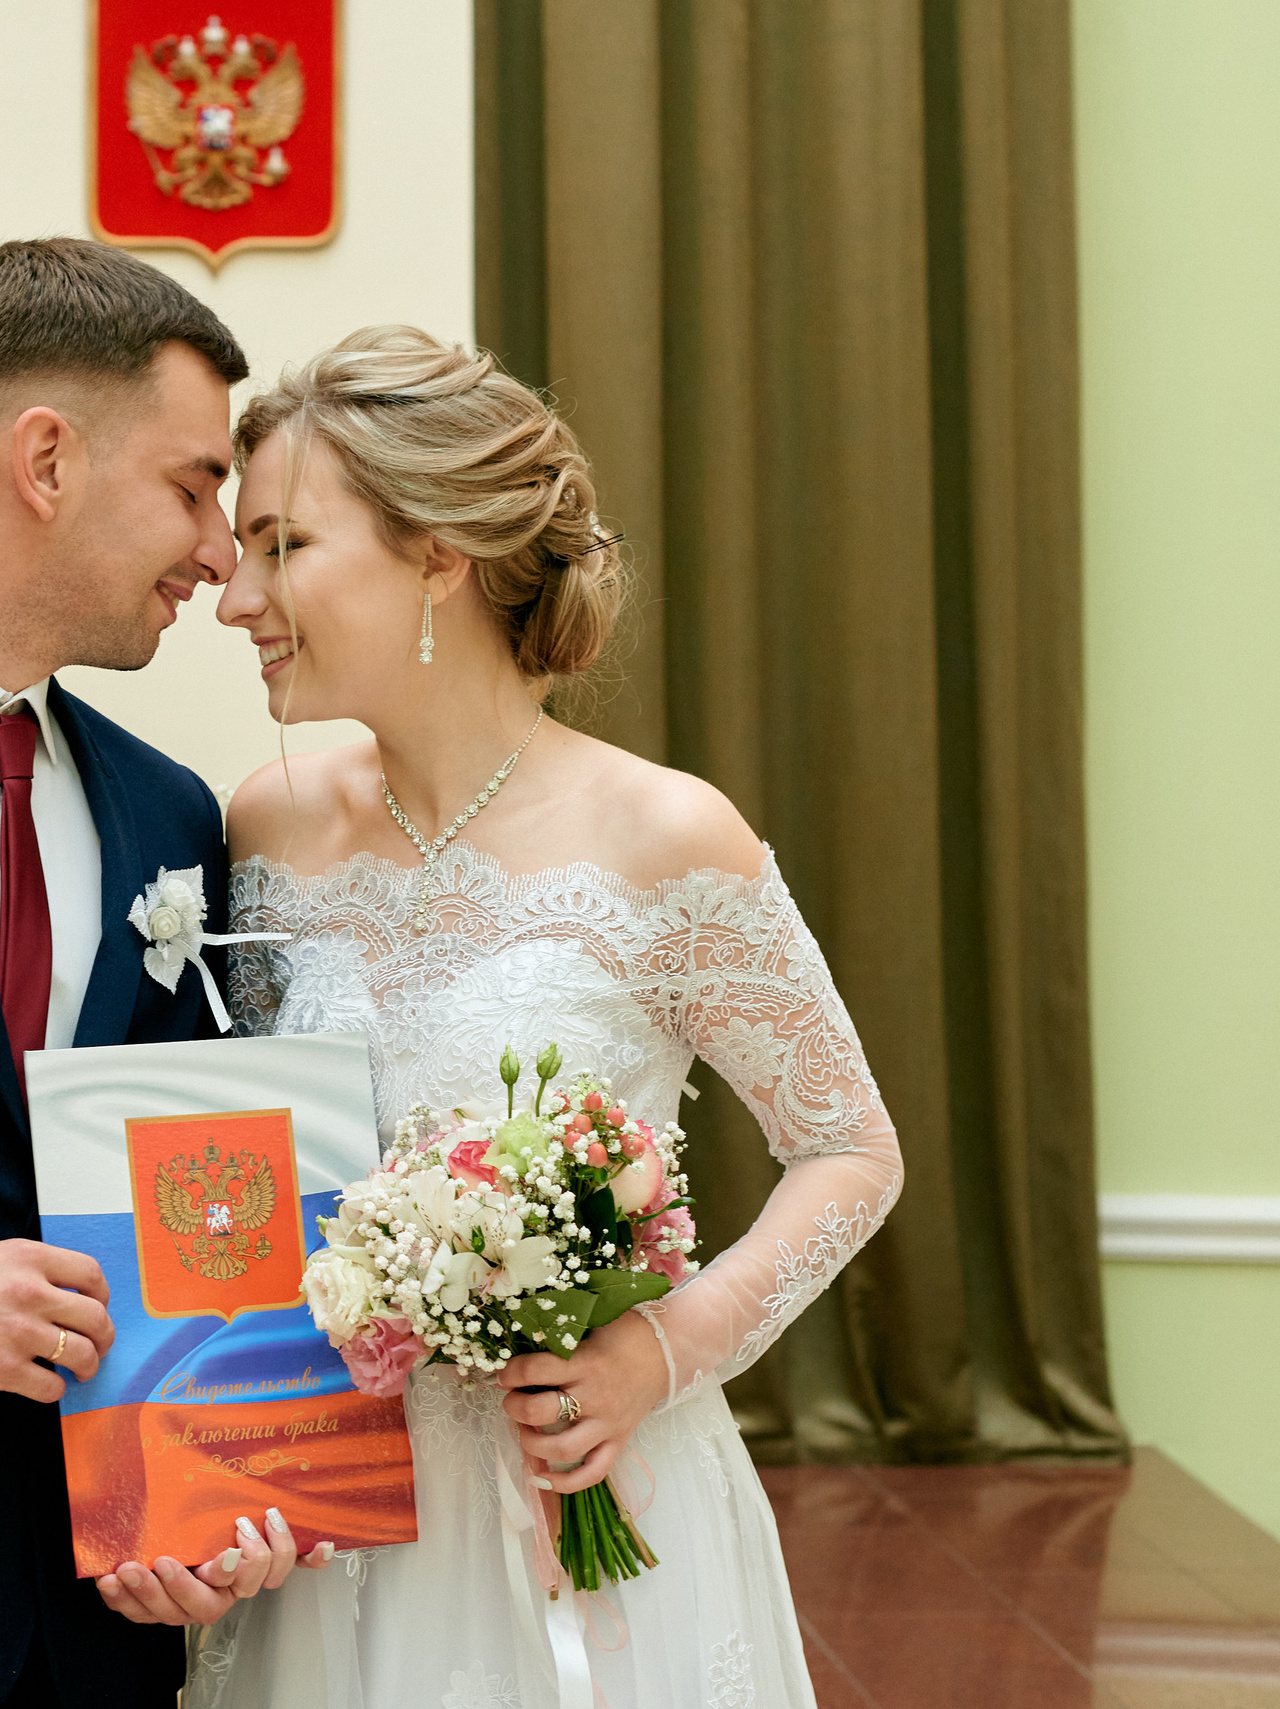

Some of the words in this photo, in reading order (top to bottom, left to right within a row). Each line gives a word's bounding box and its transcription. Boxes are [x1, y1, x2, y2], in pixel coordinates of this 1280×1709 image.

[152, 1366, 321, 1406] Свидетельство
[142, 1437, 152, 1449] о
[155, 1422, 276, 1455] заключении
[283, 1411, 339, 1443] брака
